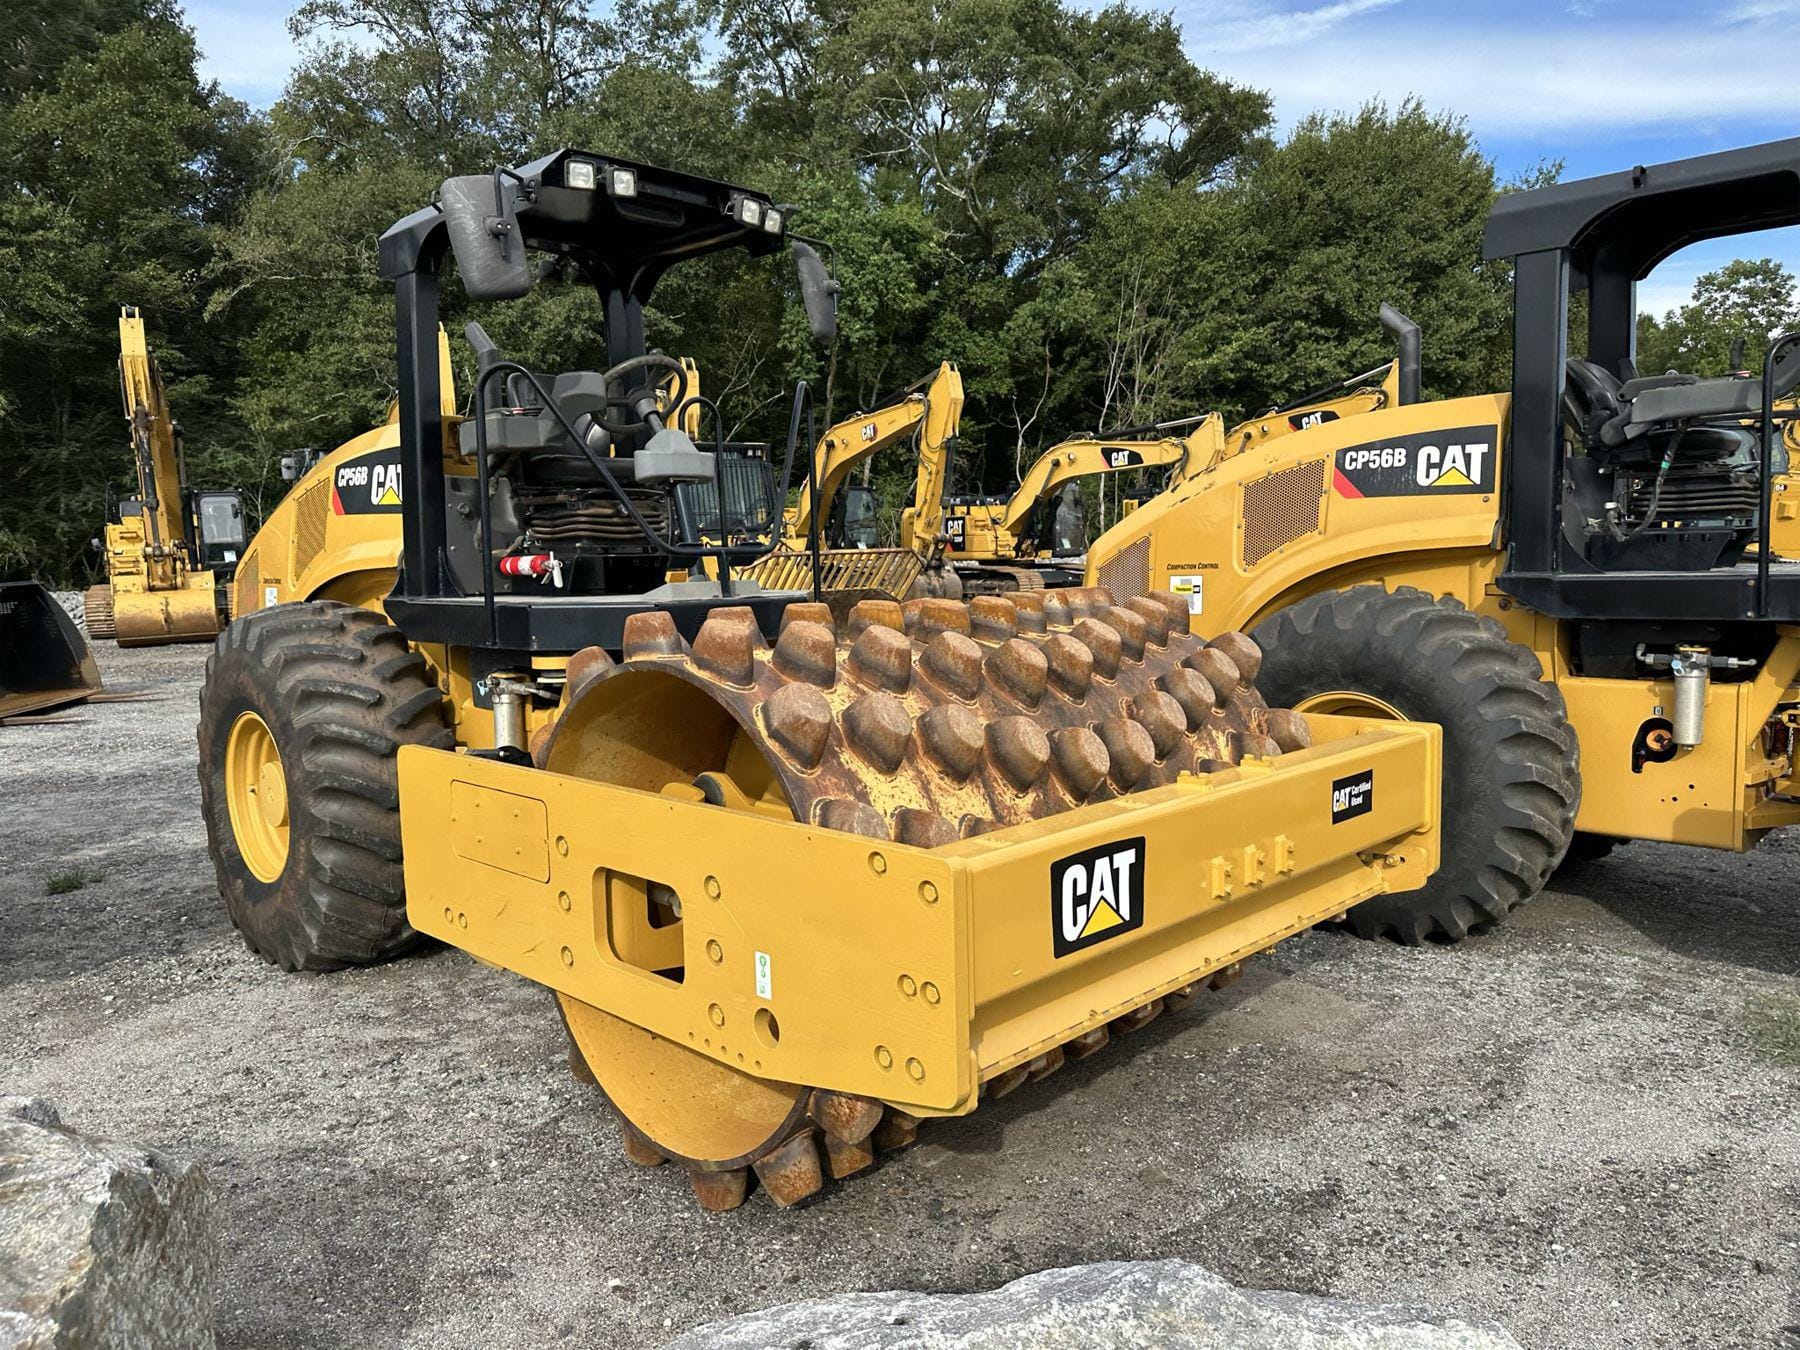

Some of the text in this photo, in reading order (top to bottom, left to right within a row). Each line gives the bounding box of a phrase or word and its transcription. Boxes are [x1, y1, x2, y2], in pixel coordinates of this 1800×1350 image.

[1301, 411, 1322, 430] CAT
[861, 423, 875, 441] CAT
[1111, 450, 1130, 467] CAT
[1344, 443, 1489, 487] CP56B CAT
[337, 466, 369, 487] CP56B
[947, 519, 964, 535] CAT
[1333, 780, 1372, 813] CAT Certified
[1350, 794, 1364, 807] Used
[1061, 847, 1137, 942] CAT
